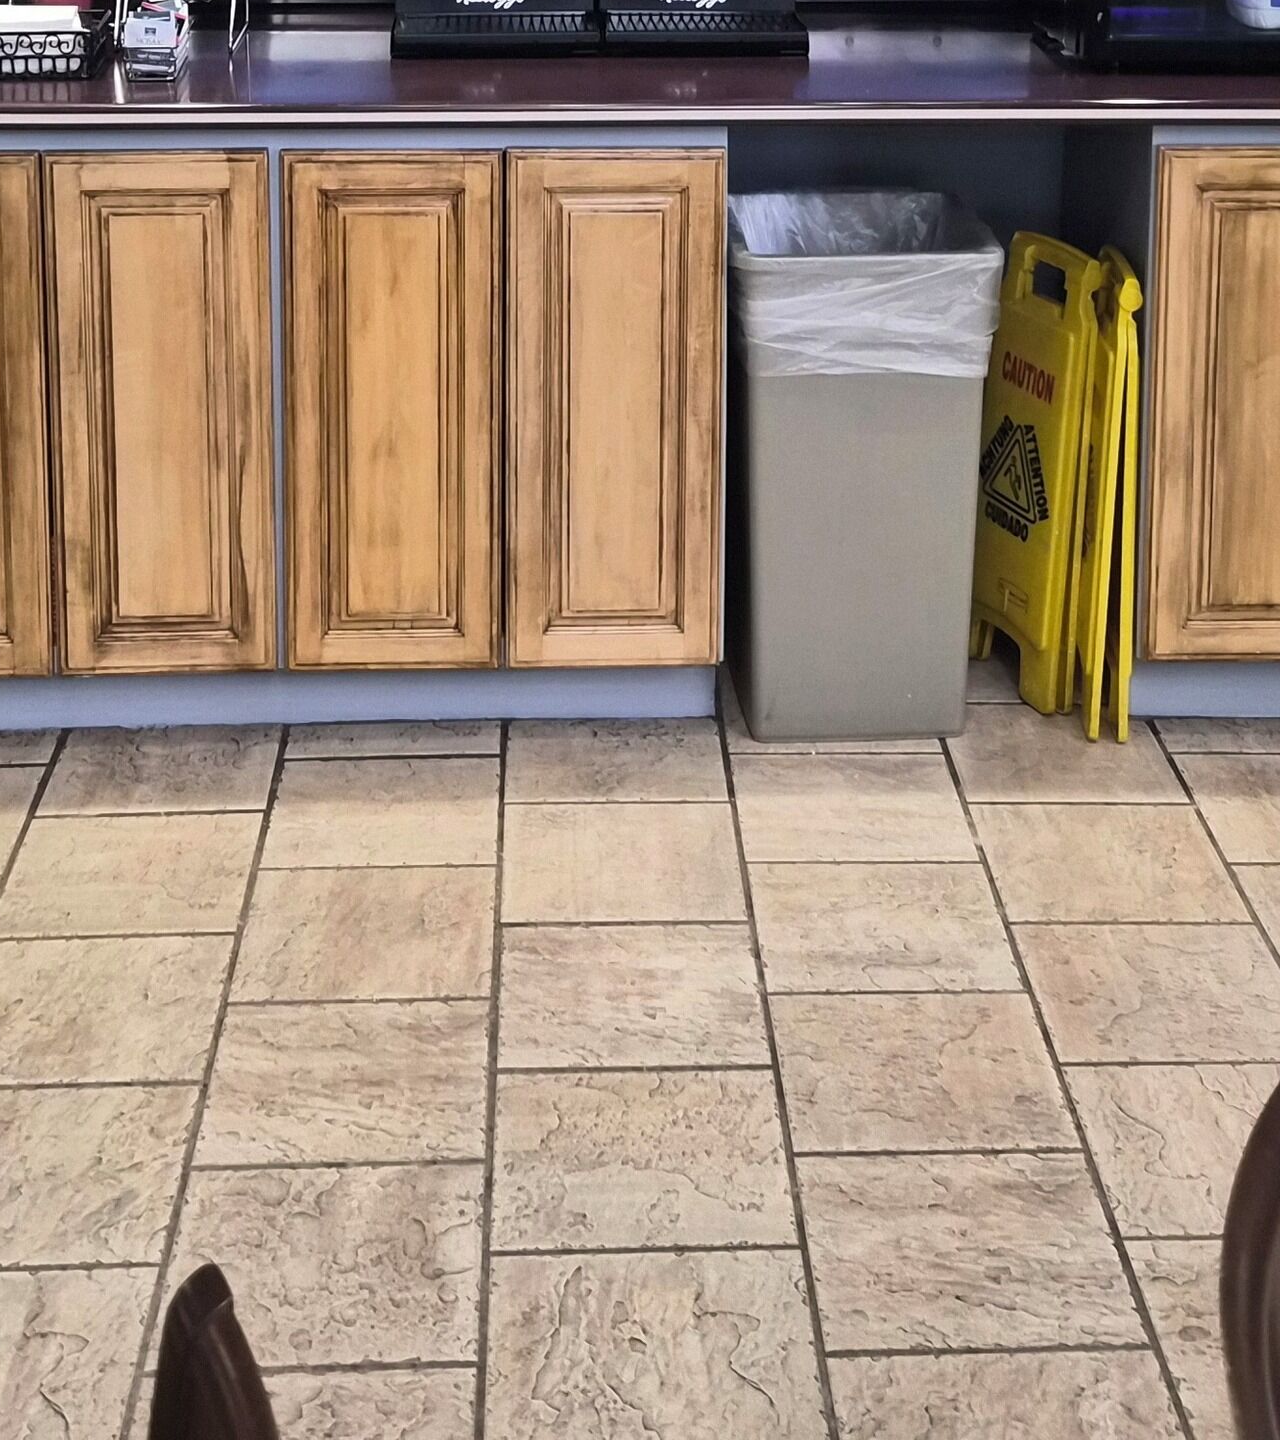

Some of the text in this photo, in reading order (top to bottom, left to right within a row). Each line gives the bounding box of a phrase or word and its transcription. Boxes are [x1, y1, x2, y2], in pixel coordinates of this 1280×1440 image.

[1002, 350, 1056, 405] CAUTION
[1023, 424, 1050, 522] ATTENTION
[985, 500, 1029, 542] CUIDADO
